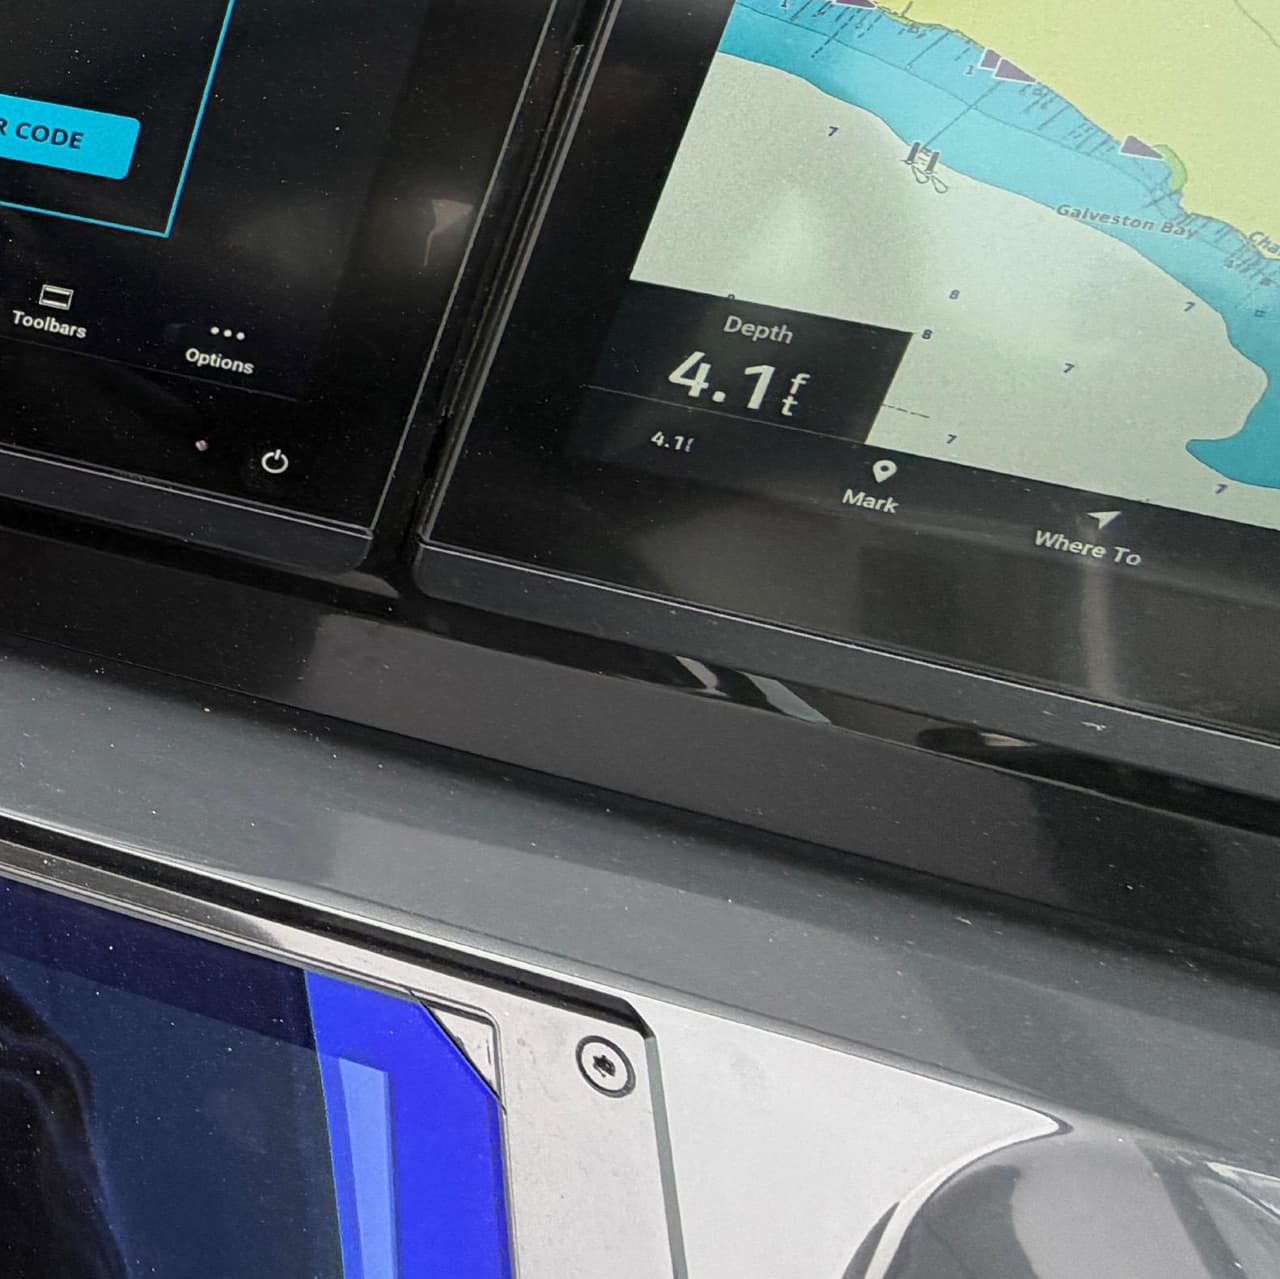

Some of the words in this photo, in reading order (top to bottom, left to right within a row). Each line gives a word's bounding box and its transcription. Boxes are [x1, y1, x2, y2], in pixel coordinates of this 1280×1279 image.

[15, 121, 84, 151] CODE
[1055, 203, 1155, 232] Galveston
[1160, 222, 1200, 241] Bay
[11, 310, 88, 339] Toolbars
[723, 314, 794, 344] Depth
[184, 347, 255, 375] Options
[842, 488, 901, 515] Mark
[1034, 529, 1107, 560] Where
[1112, 546, 1143, 567] To
